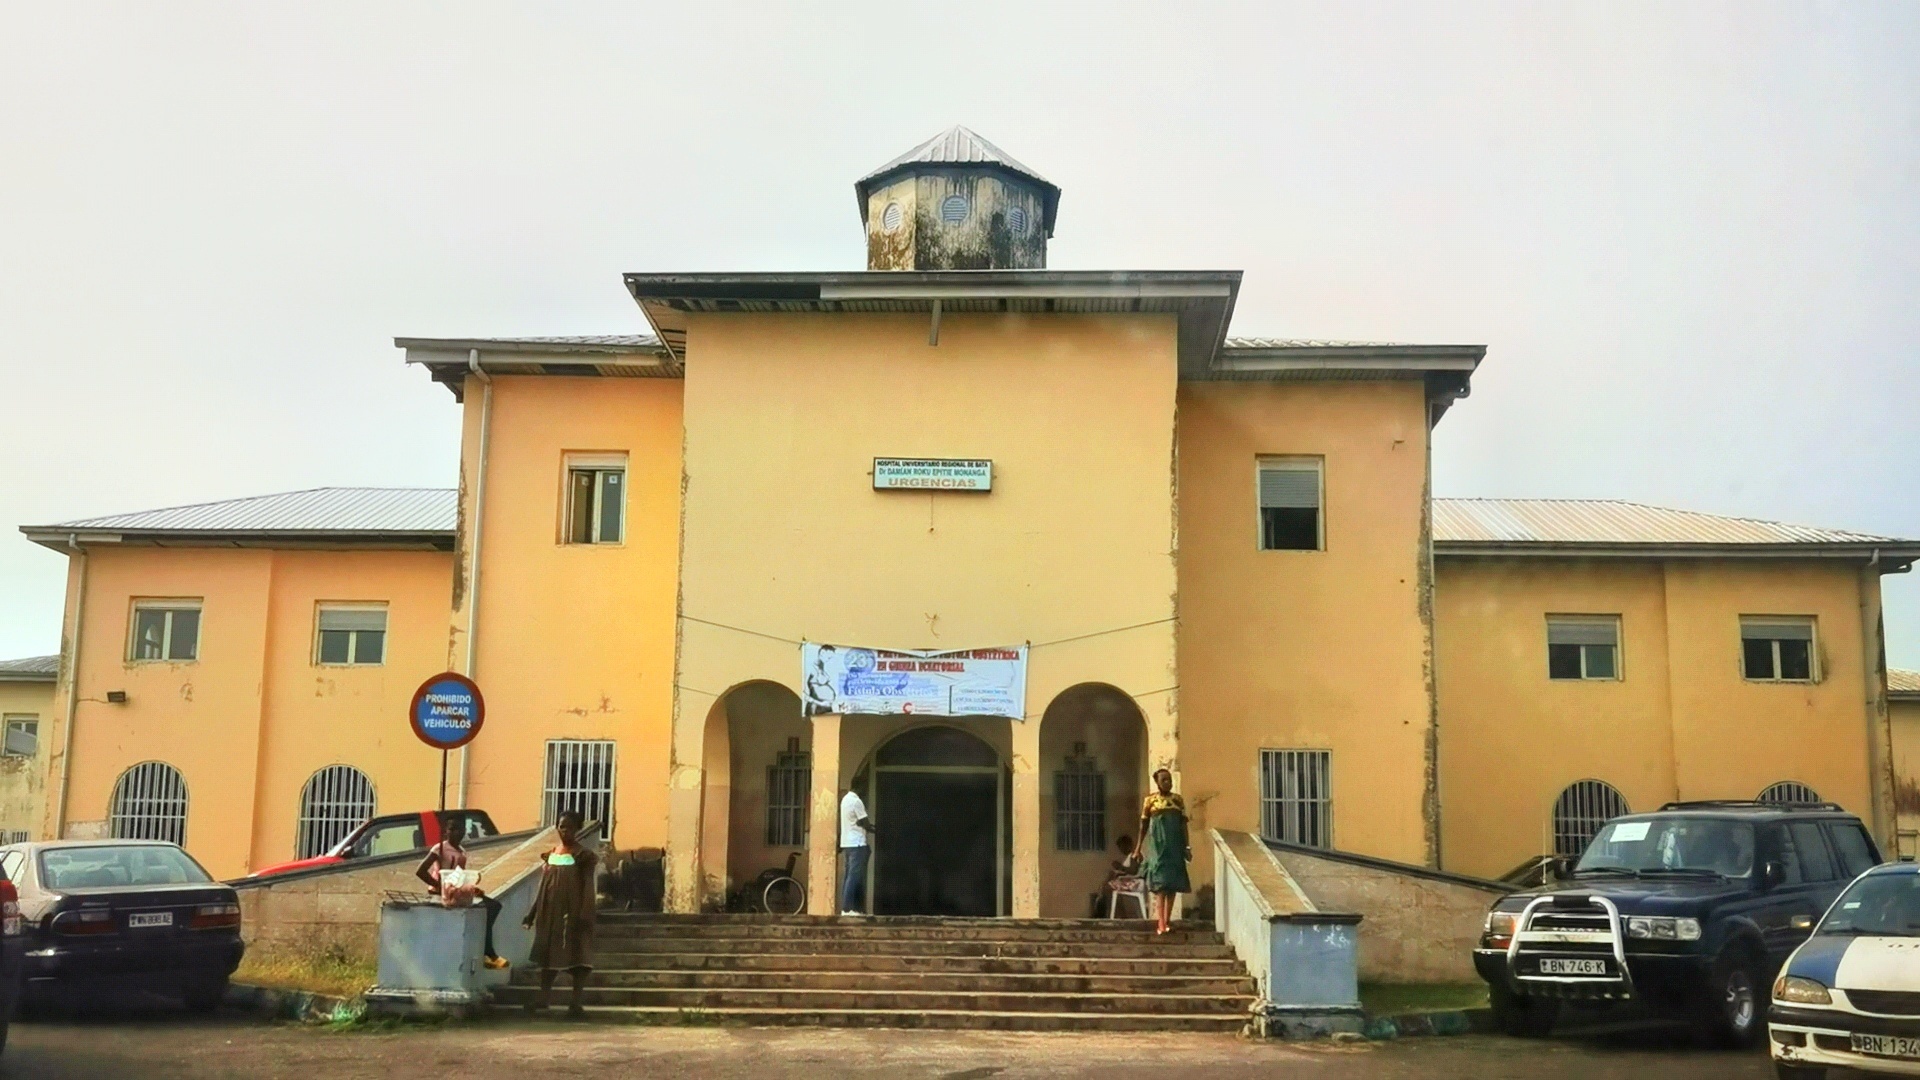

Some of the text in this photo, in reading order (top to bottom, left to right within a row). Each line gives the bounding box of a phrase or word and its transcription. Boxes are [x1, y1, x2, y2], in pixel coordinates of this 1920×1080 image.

[888, 478, 977, 488] URGENCIAS
[425, 694, 472, 704] PROHIBIDO
[430, 706, 470, 716] APARCAR
[423, 719, 472, 729] VEHICULOS
